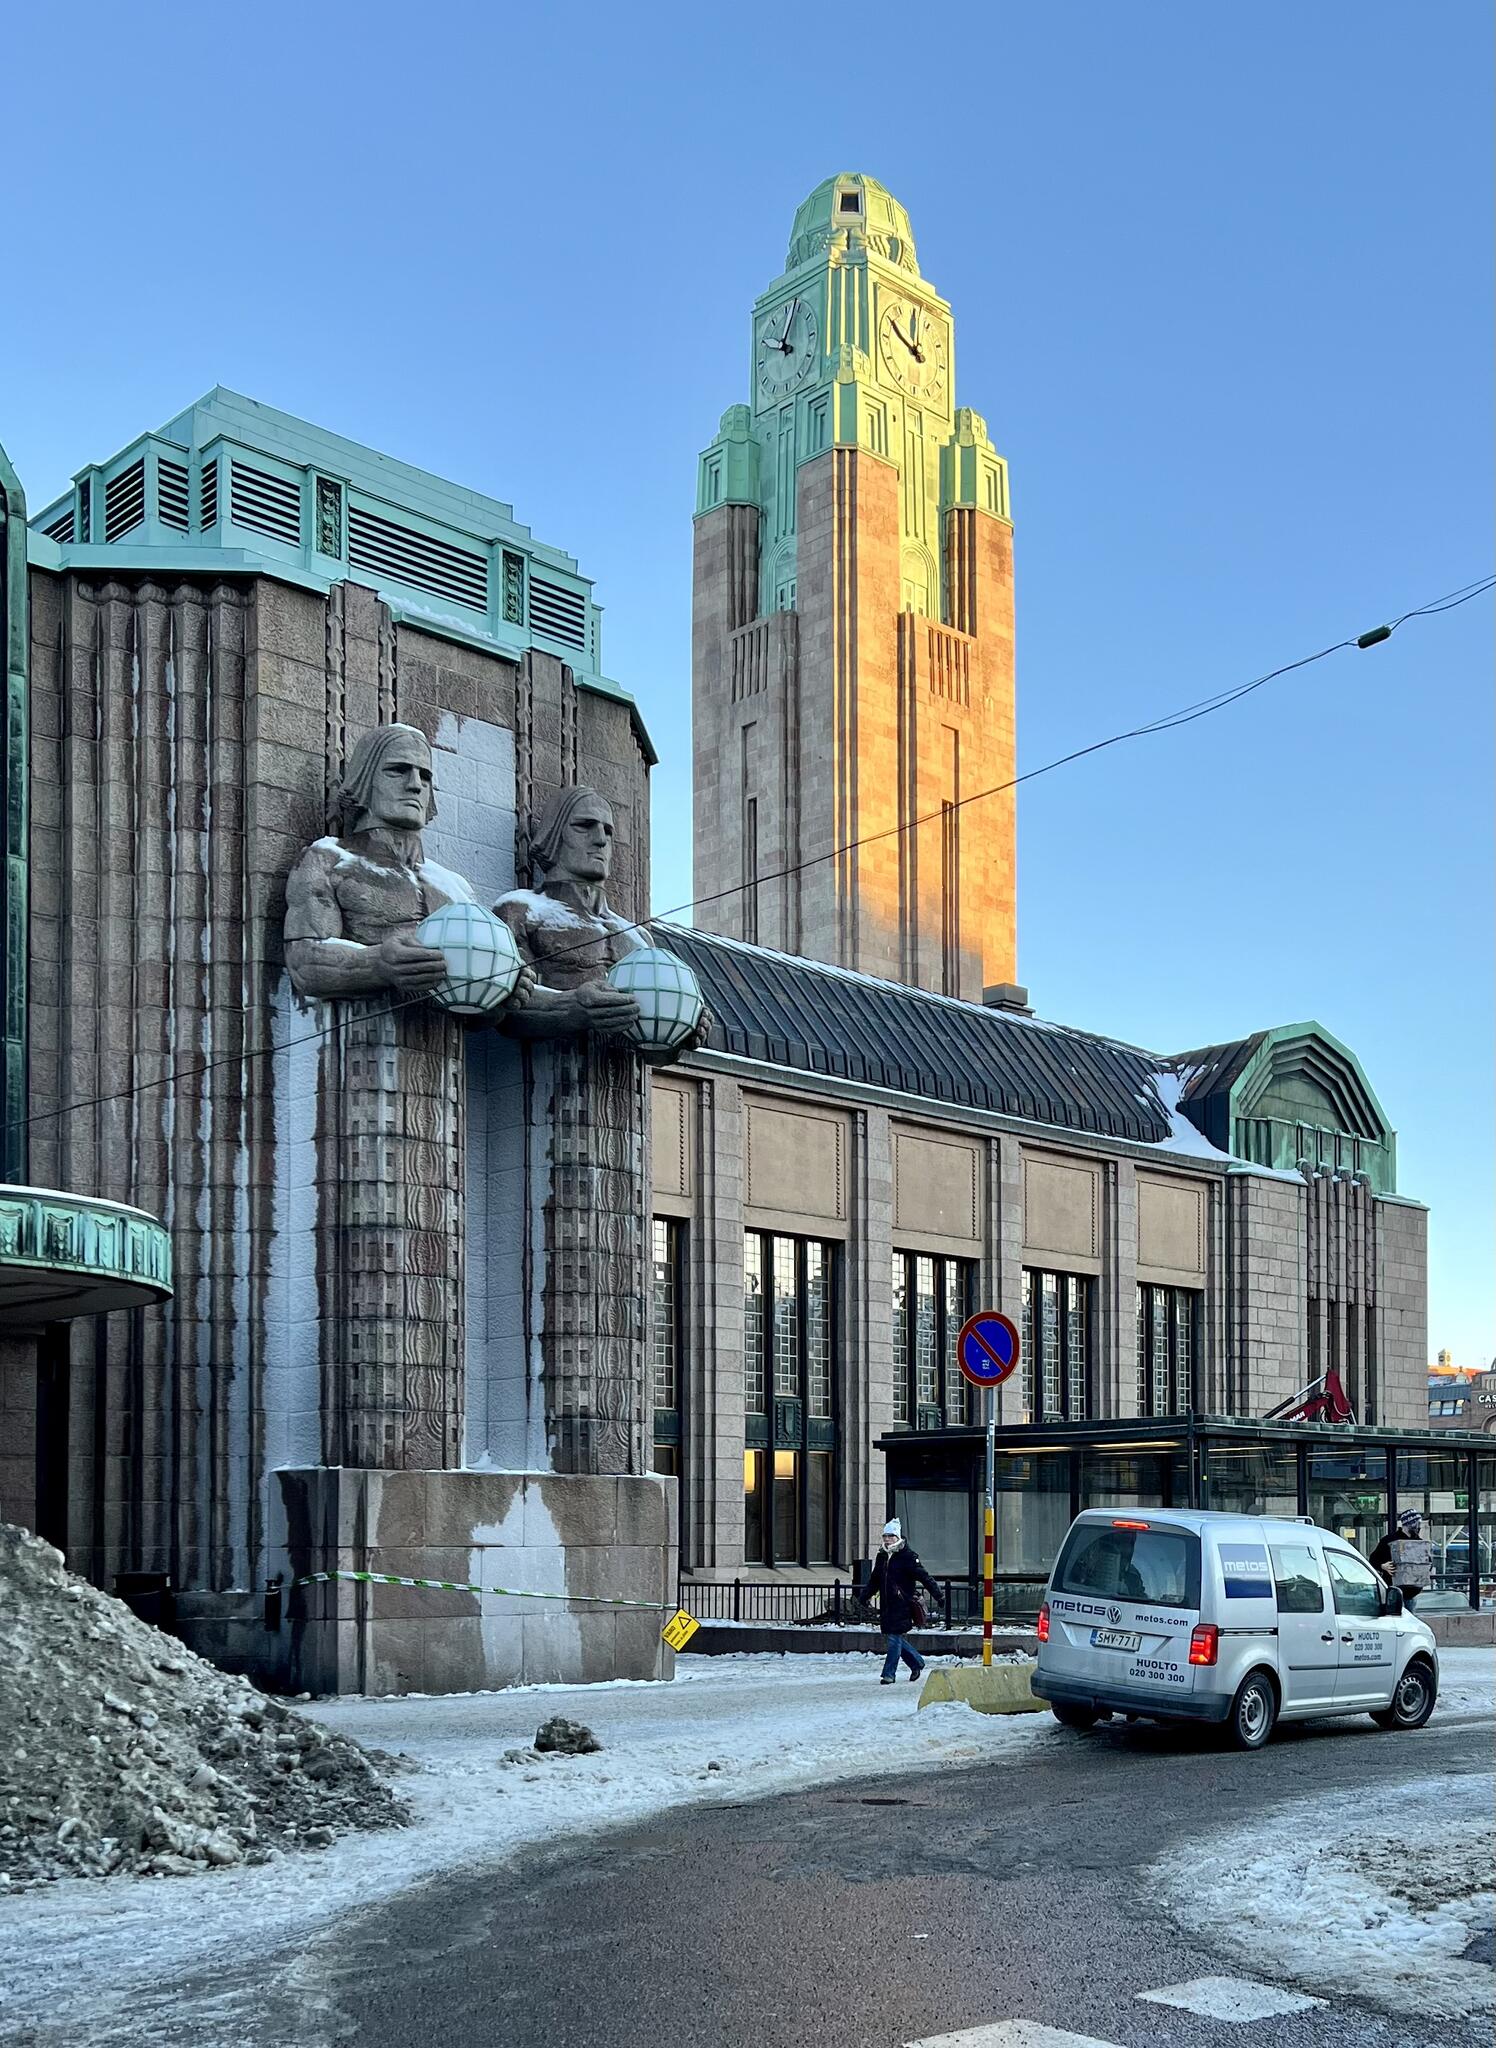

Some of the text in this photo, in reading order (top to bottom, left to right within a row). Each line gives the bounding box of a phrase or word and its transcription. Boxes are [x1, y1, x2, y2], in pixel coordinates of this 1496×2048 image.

[1223, 1560, 1269, 1572] metos
[1052, 1600, 1106, 1615] metos
[1135, 1614, 1188, 1626] metos.com
[1358, 1632, 1380, 1641] HUOLTO
[1354, 1653, 1382, 1661] metos.com
[1136, 1658, 1178, 1672] HUOLTO
[1129, 1668, 1185, 1683] 020 300 300
